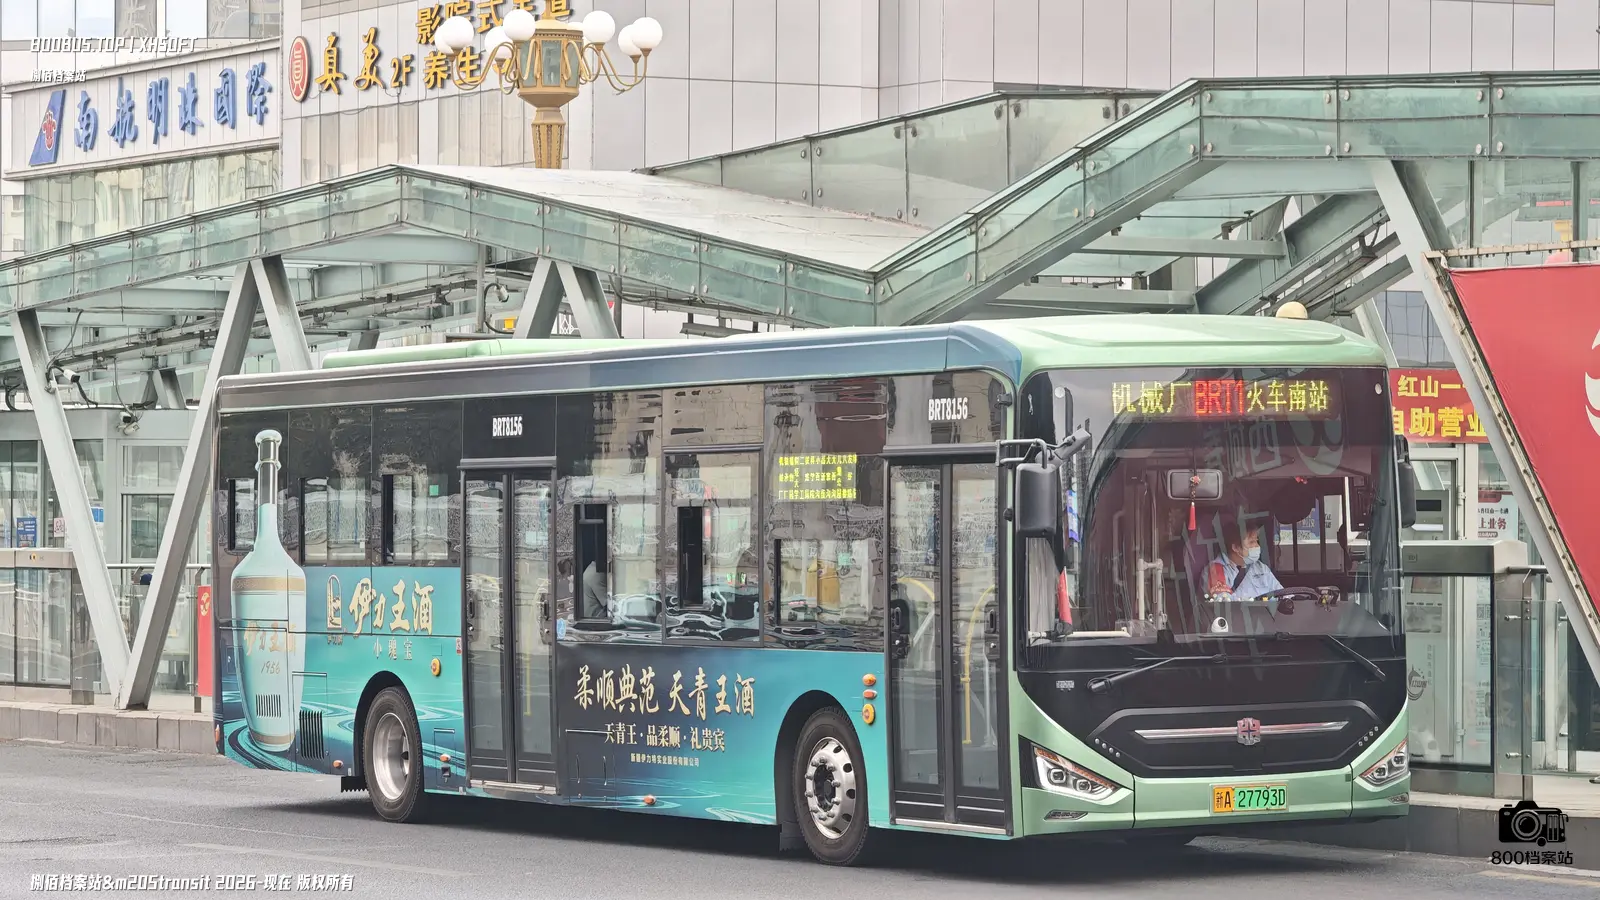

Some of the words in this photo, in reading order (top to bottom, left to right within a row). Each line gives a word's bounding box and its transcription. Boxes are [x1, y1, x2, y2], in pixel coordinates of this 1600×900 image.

[315, 27, 386, 95] 真美
[391, 54, 414, 88] 2F
[424, 47, 512, 90] 养生
[1111, 381, 1192, 414] 机械厂
[1194, 379, 1245, 415] BRT1
[1246, 380, 1329, 412] 火车南站
[1397, 374, 1467, 398] 红山一
[928, 397, 968, 421] BRT8156
[492, 416, 523, 437] BRT8156
[348, 577, 435, 639] 伊力王酒
[261, 660, 281, 675] 1956
[574, 663, 660, 715] 柔顺典范
[668, 666, 756, 721] 天青王酒
